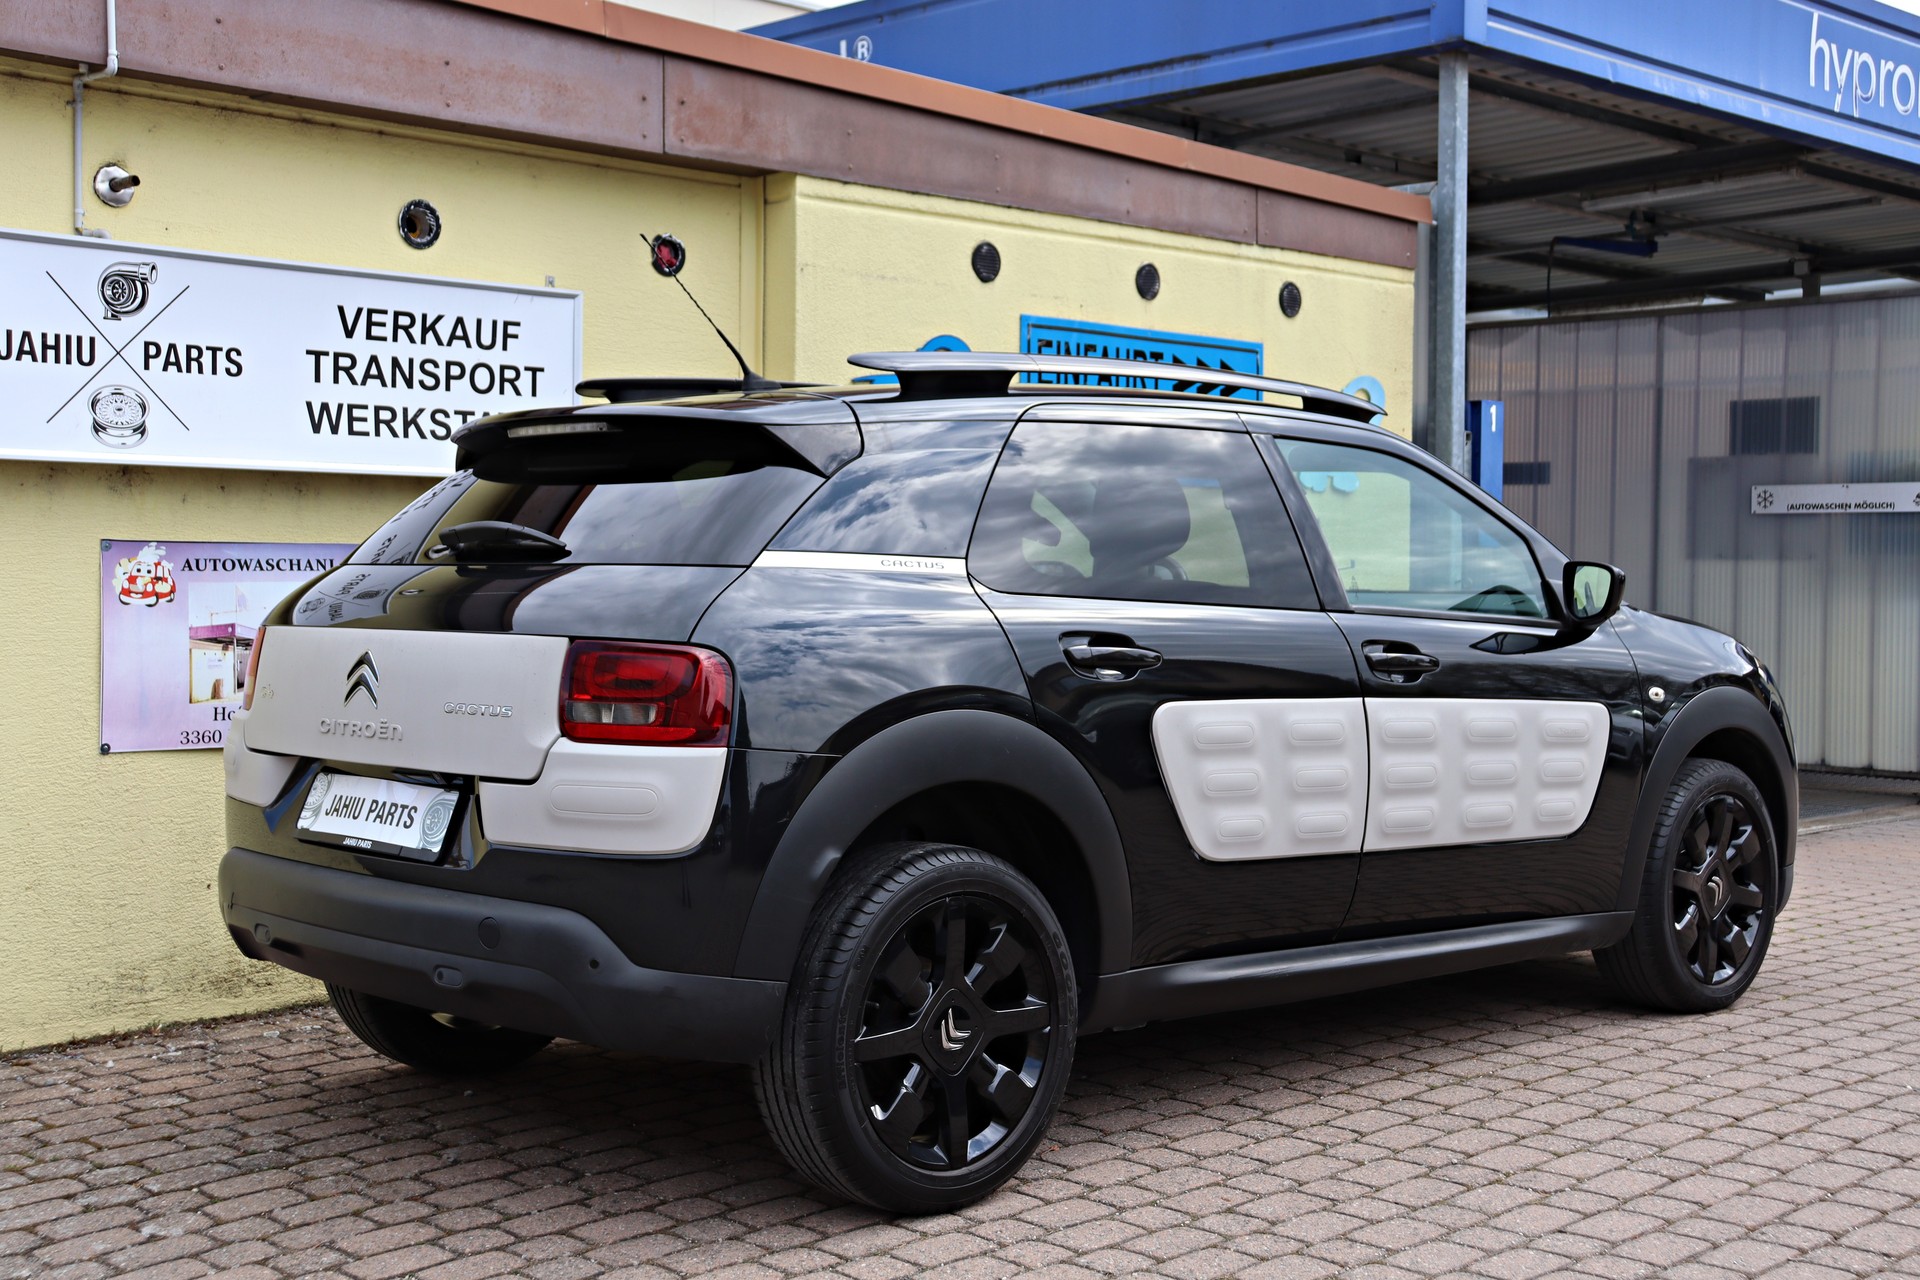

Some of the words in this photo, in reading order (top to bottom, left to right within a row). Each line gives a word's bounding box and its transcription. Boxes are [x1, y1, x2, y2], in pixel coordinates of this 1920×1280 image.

[1809, 11, 1920, 118] hypro
[337, 305, 521, 351] VERKAUF
[0, 329, 96, 367] JAHIU
[143, 341, 243, 377] PARTS
[306, 349, 545, 397] TRANSPORT
[305, 401, 504, 441] WERKST
[1490, 404, 1497, 432] 1
[1786, 502, 1851, 511] (AUTOWASCHEN
[1854, 500, 1895, 511] MÖGLICH)
[880, 559, 945, 569] CACTUS
[443, 702, 514, 718] CACTUS
[180, 729, 222, 745] 3360
[325, 794, 366, 820] JAHIU
[364, 799, 418, 829] PARTS
